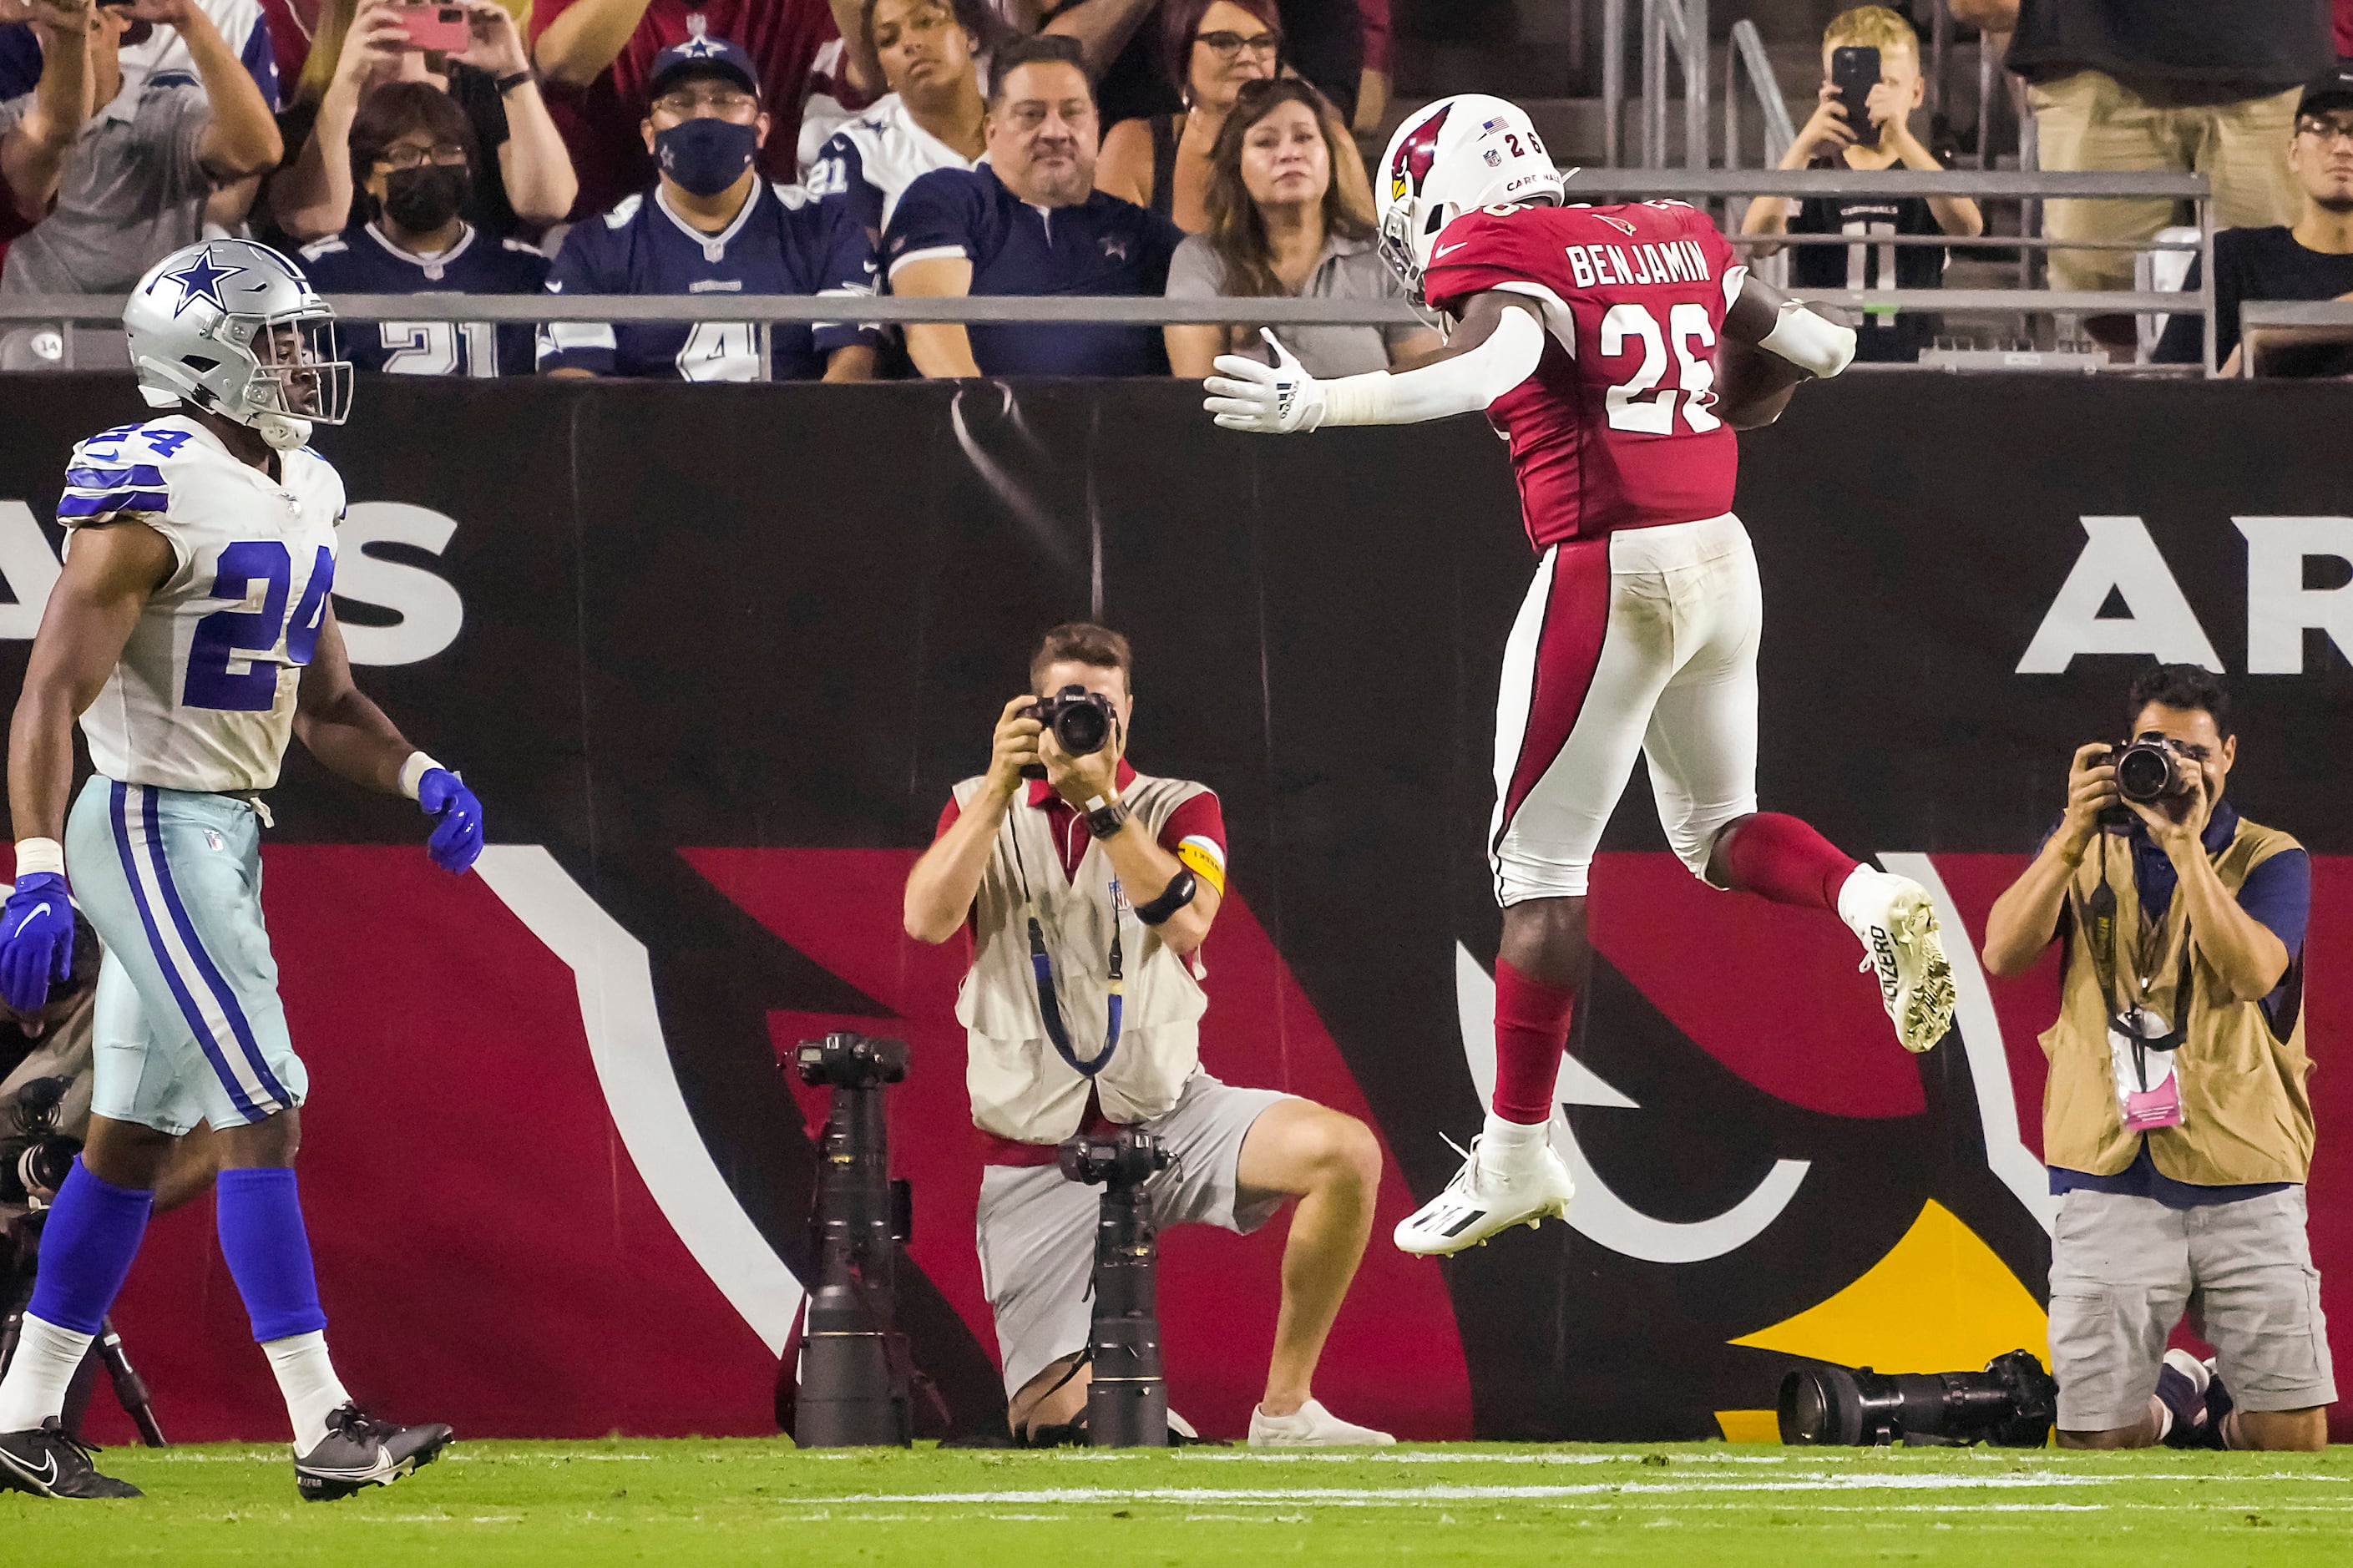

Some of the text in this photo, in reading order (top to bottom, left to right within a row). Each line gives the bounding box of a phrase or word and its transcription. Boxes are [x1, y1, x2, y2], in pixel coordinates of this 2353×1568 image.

[1565, 240, 1711, 288] BENJAMIN
[676, 321, 759, 382] 4
[1601, 302, 1722, 436] 26
[83, 422, 194, 458] 24
